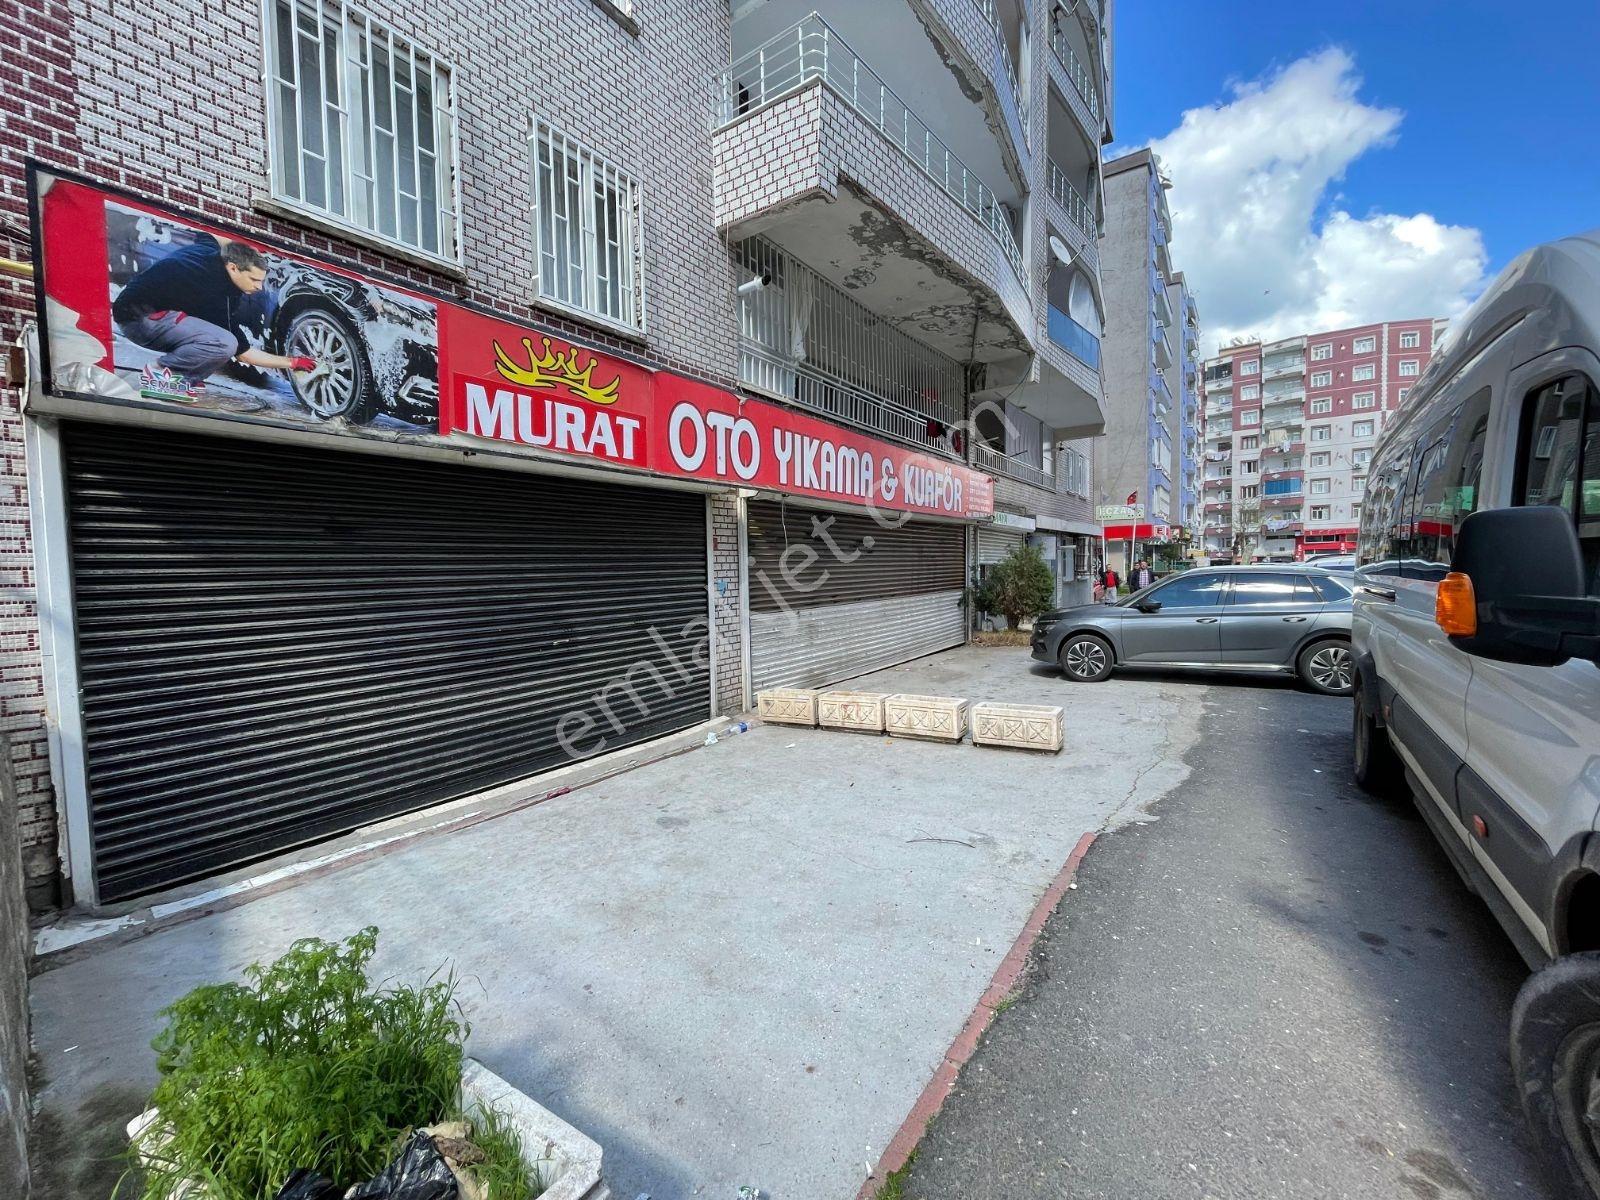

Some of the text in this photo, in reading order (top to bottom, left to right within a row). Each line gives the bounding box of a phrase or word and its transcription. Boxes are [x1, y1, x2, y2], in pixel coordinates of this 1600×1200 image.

[465, 382, 640, 460] MURAT
[668, 402, 760, 480] OTO
[773, 427, 874, 498] YIKAMA
[881, 458, 899, 501] &
[904, 463, 963, 512] KUAFÖR
